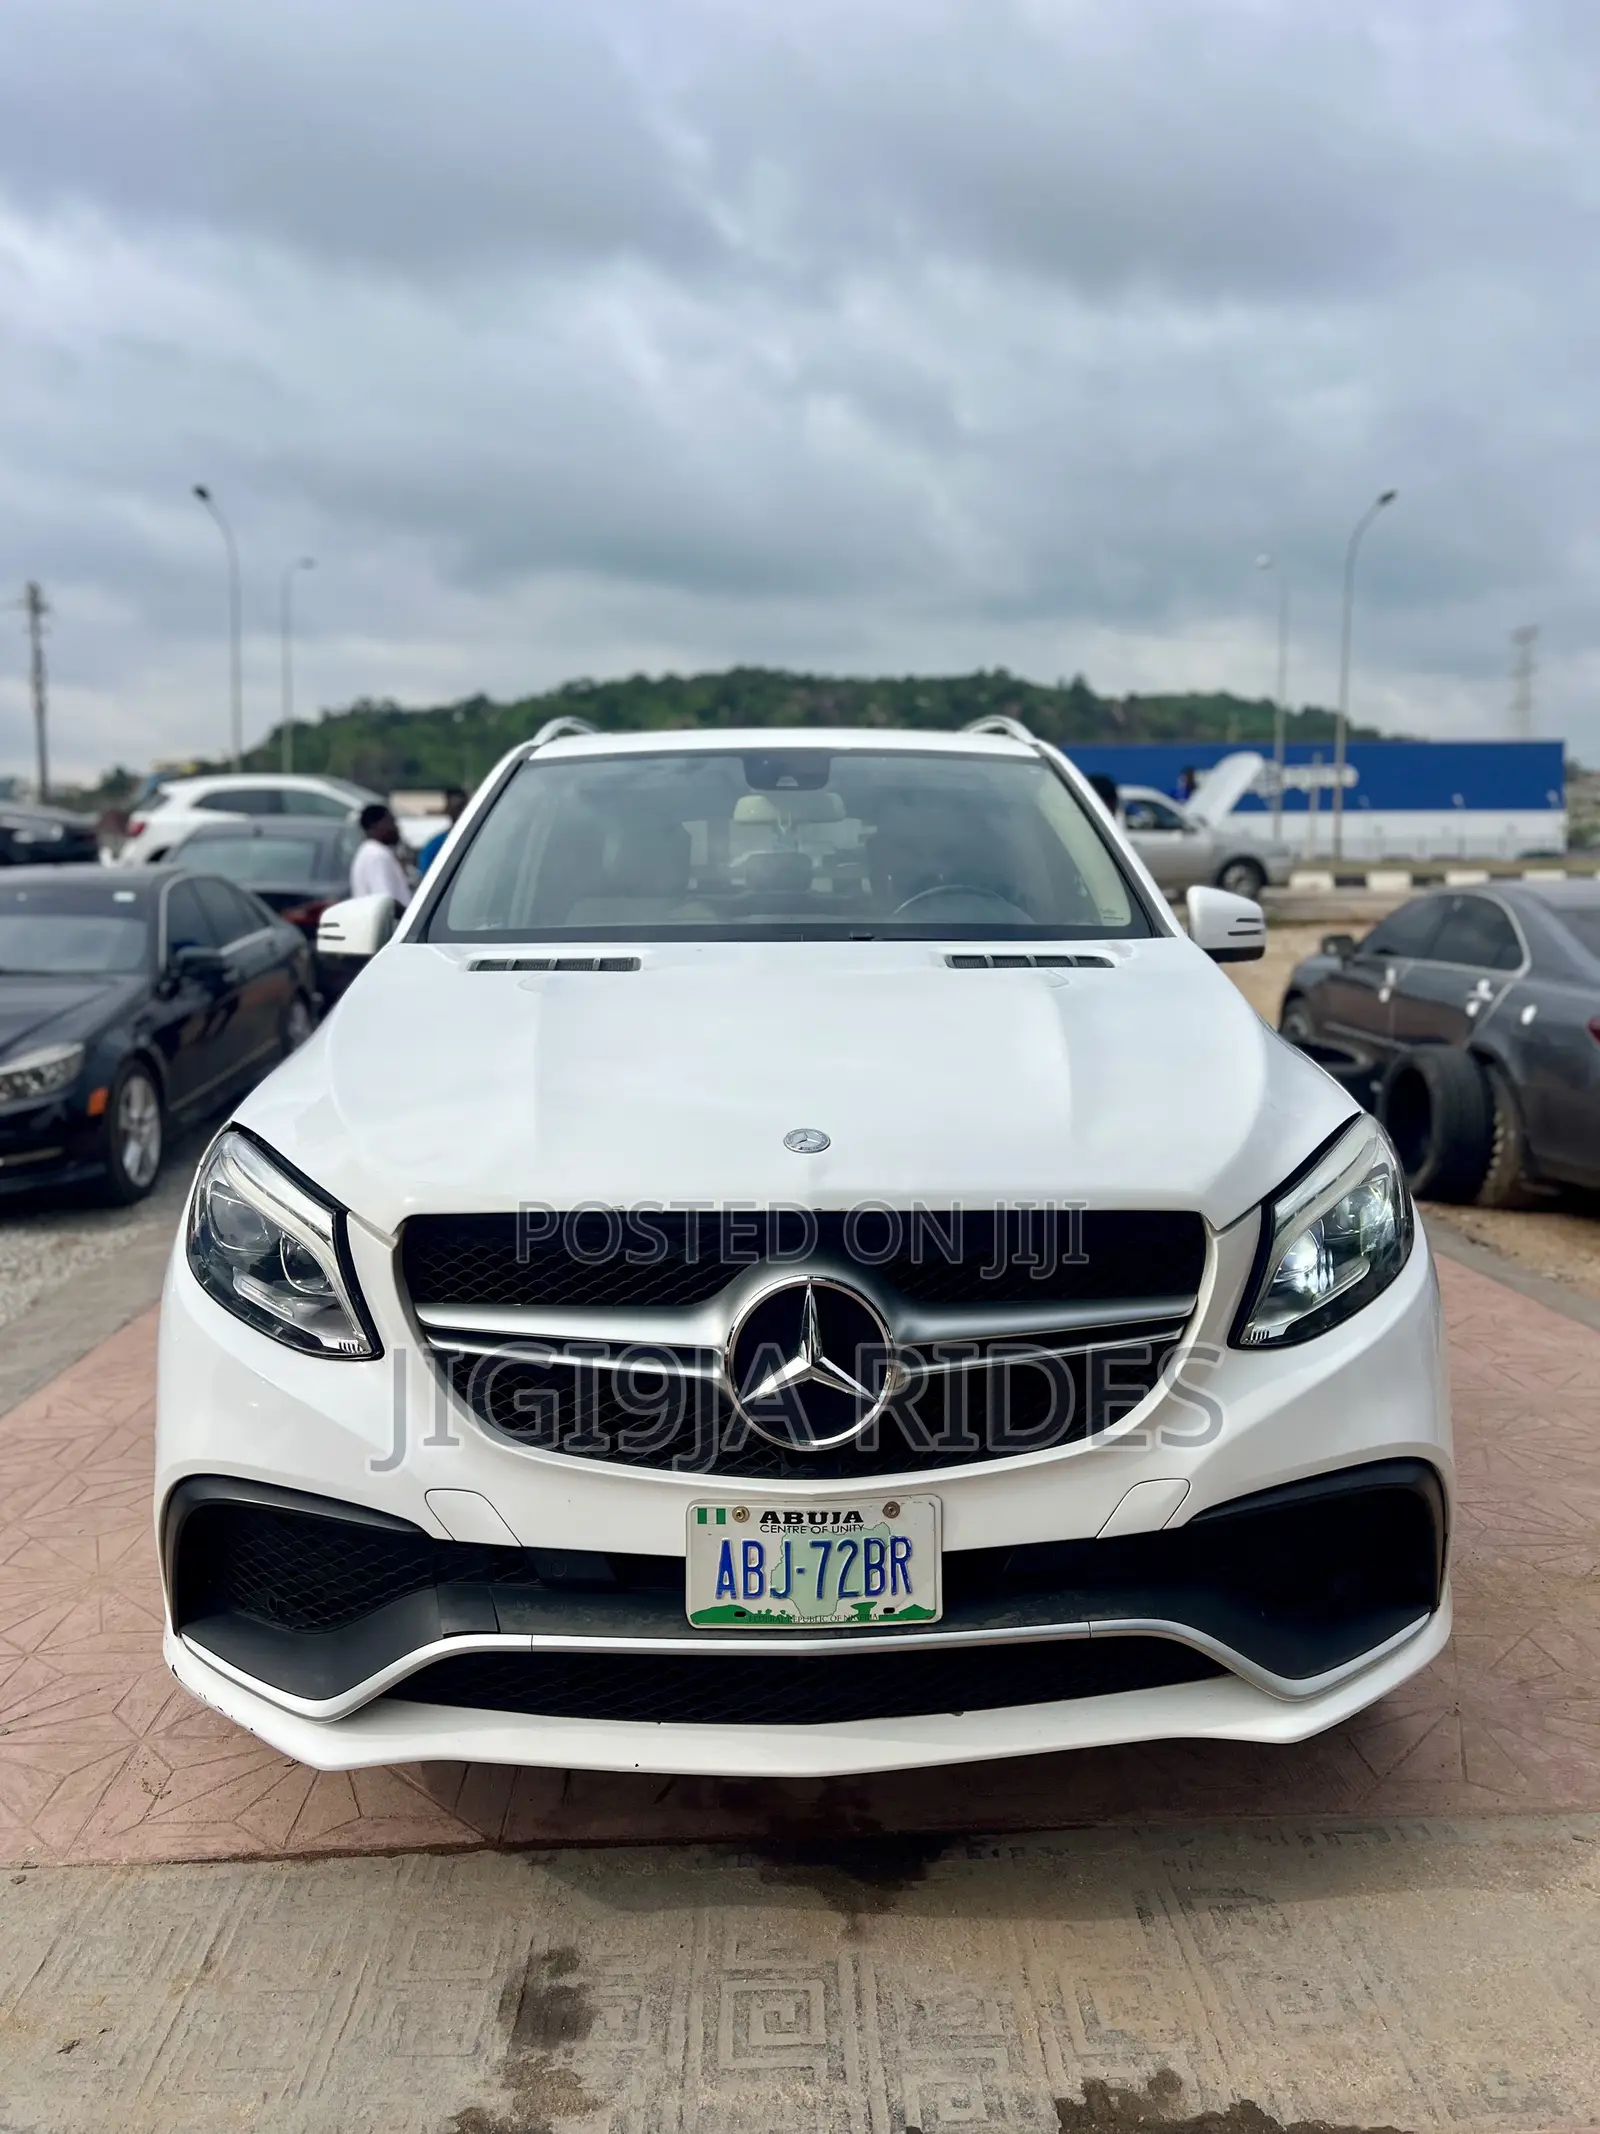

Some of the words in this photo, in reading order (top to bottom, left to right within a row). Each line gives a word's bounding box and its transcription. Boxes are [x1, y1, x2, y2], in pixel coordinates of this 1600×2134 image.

[759, 1510, 864, 1525] ABUJA
[760, 1524, 807, 1534] CENTRE
[810, 1525, 828, 1534] OF
[831, 1524, 865, 1533] UNITY
[715, 1535, 913, 1600] ABJ-72BR
